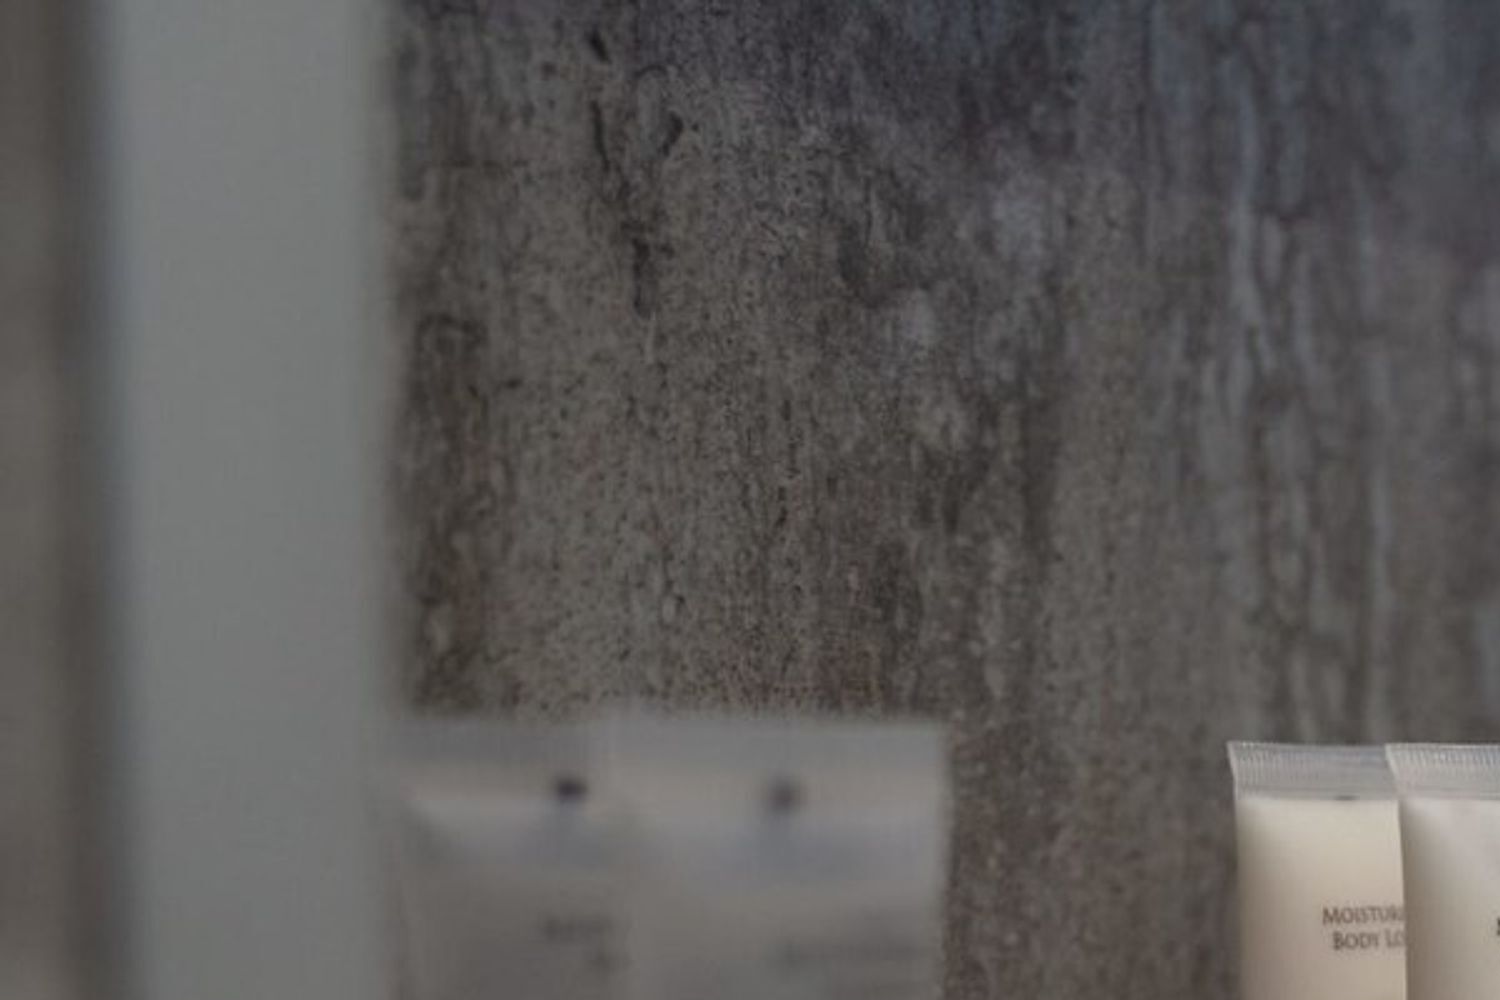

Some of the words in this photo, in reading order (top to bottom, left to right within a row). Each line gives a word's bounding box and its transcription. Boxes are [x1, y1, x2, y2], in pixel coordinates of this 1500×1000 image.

[1321, 904, 1405, 925] MOISTUR
[1332, 931, 1380, 950] BODY
[1384, 928, 1405, 948] LO
